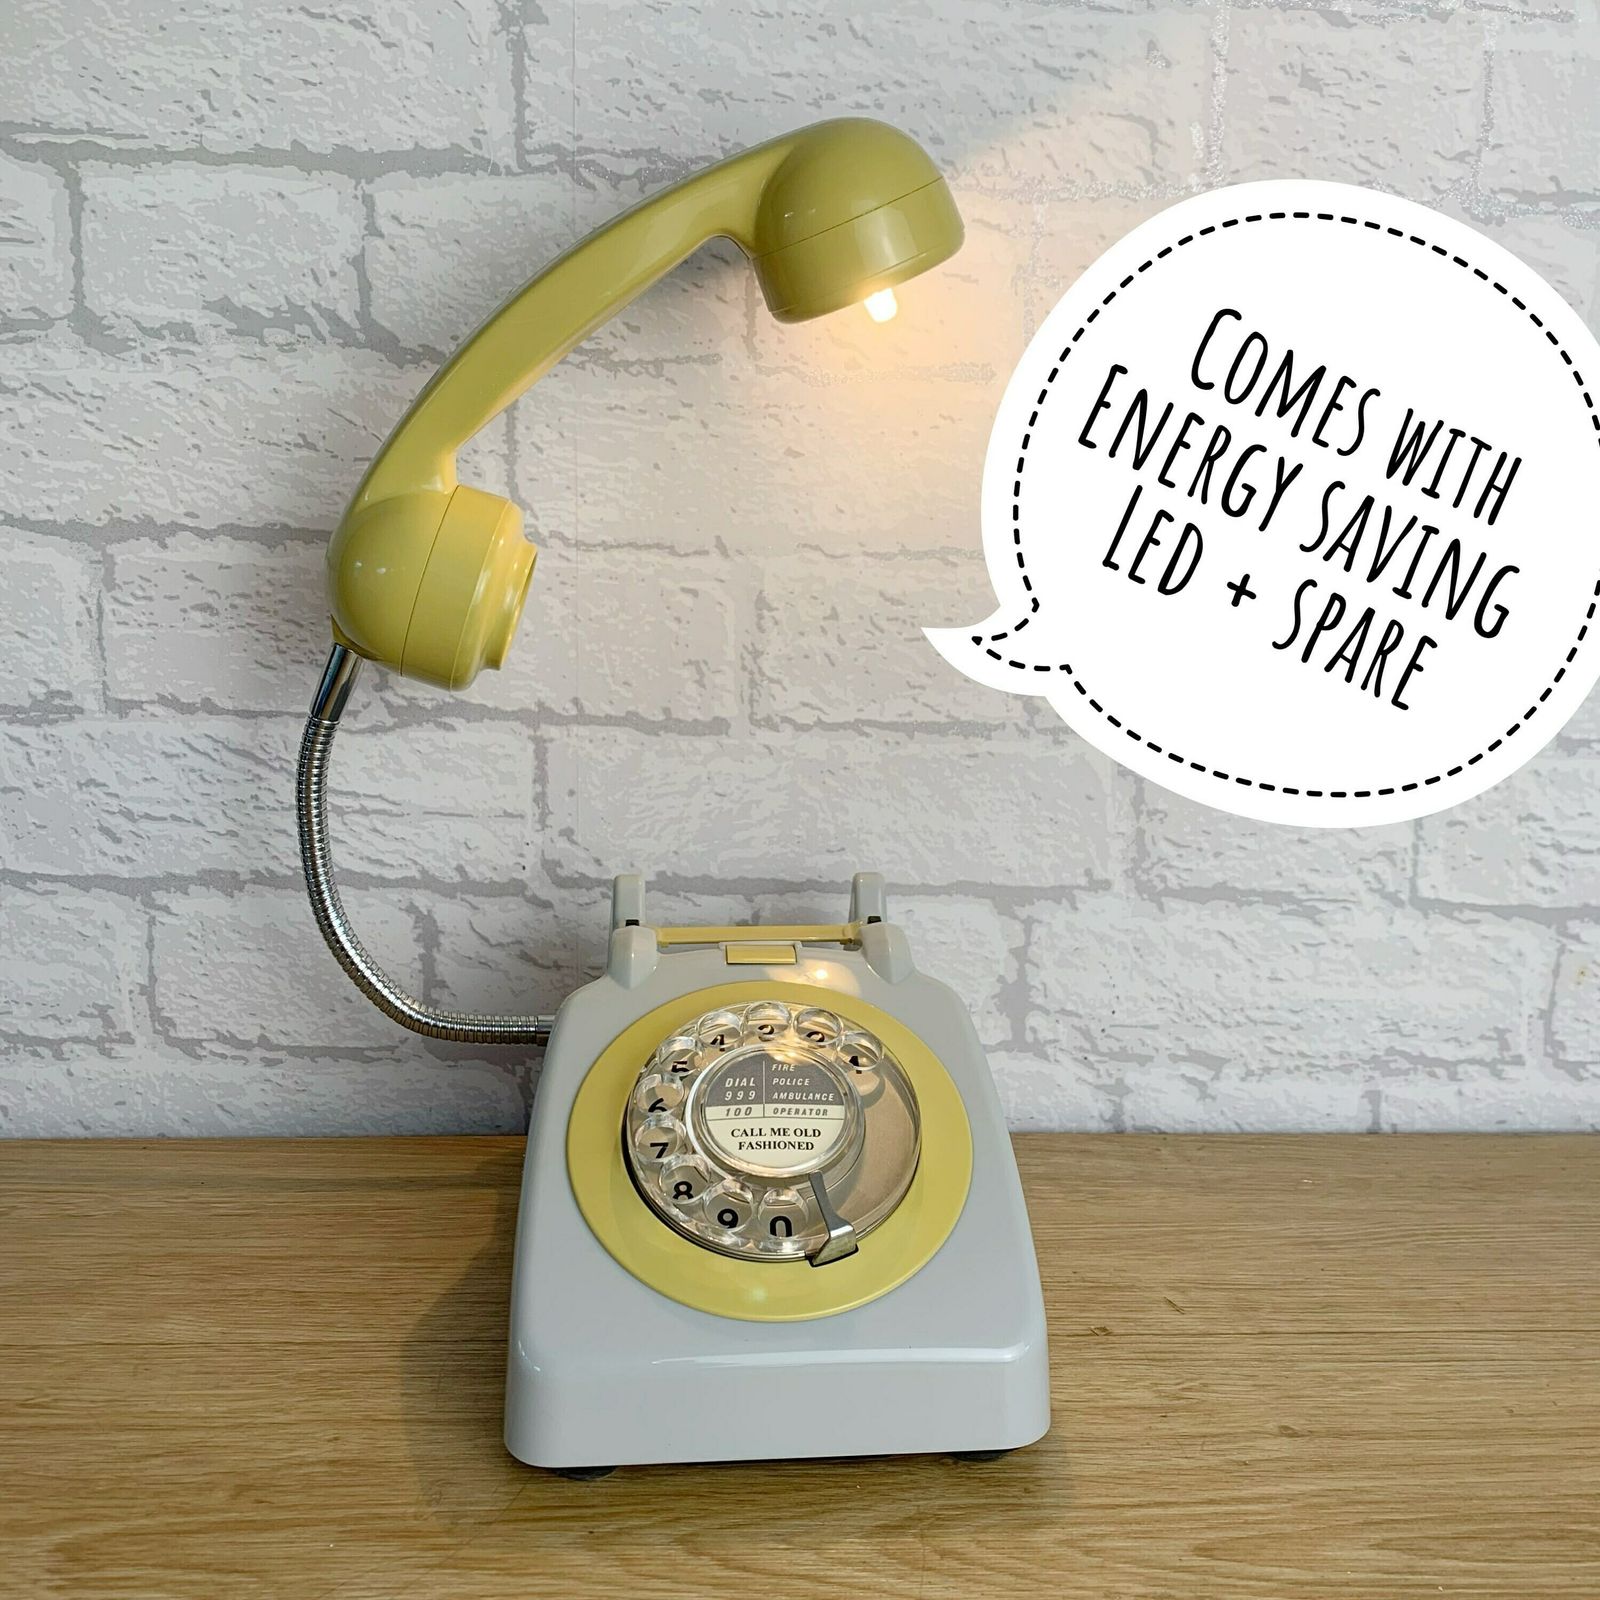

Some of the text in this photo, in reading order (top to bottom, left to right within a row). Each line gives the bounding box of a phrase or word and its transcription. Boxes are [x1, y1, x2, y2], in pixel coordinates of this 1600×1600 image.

[771, 1063, 796, 1072] FIRE
[725, 1077, 756, 1088] DIAL
[772, 1077, 810, 1086] POLICE
[772, 1091, 835, 1101] AMBULANCE
[725, 1106, 753, 1117] 100
[772, 1107, 829, 1116] OPERATOR
[730, 1128, 822, 1138] CALL ME OLD
[650, 1142, 669, 1159] 7
[738, 1140, 814, 1151] FASHIONED
[672, 1181, 694, 1200] 8
[717, 1208, 739, 1229] 9
